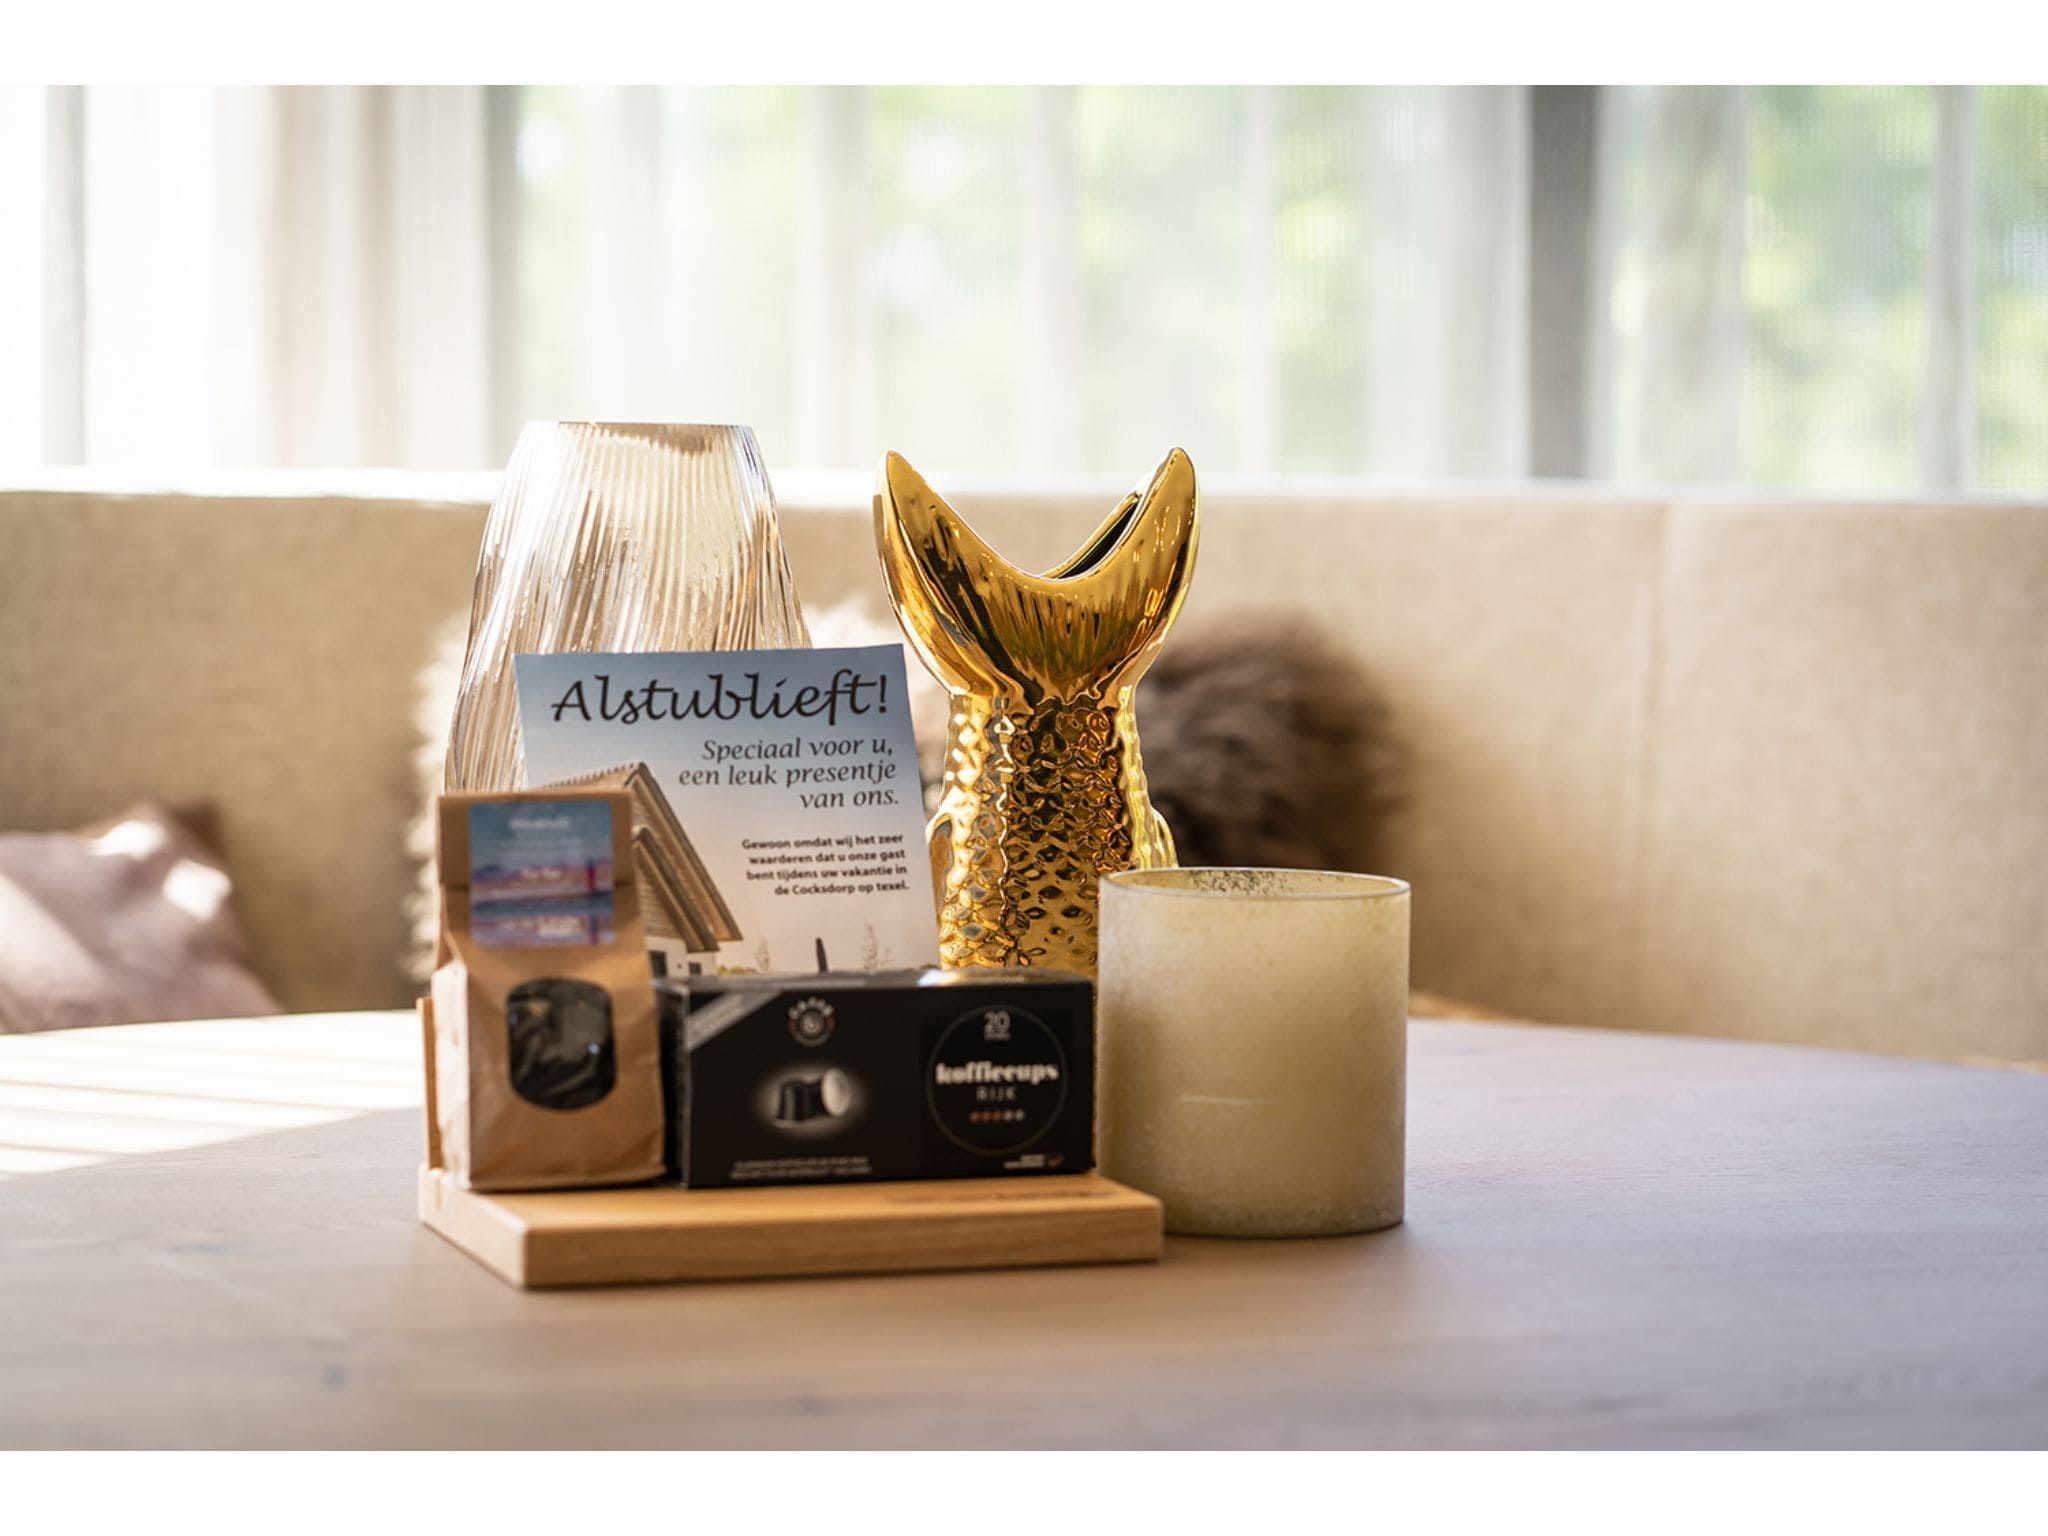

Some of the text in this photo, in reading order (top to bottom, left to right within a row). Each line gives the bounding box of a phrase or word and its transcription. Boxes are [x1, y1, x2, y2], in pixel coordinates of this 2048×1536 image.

[551, 668, 888, 727] Alstublieft!
[702, 737, 893, 764] Speciaal voor u,
[678, 760, 897, 788] een leuk presentje
[800, 788, 899, 809] van ons.
[741, 834, 904, 849] Gewoon omdat wij het zeer
[749, 849, 906, 865] waarderen dat u onze gast
[746, 864, 908, 882] bent tijdens uw vakantie in
[774, 879, 910, 896] de Cocksdorp op texel.
